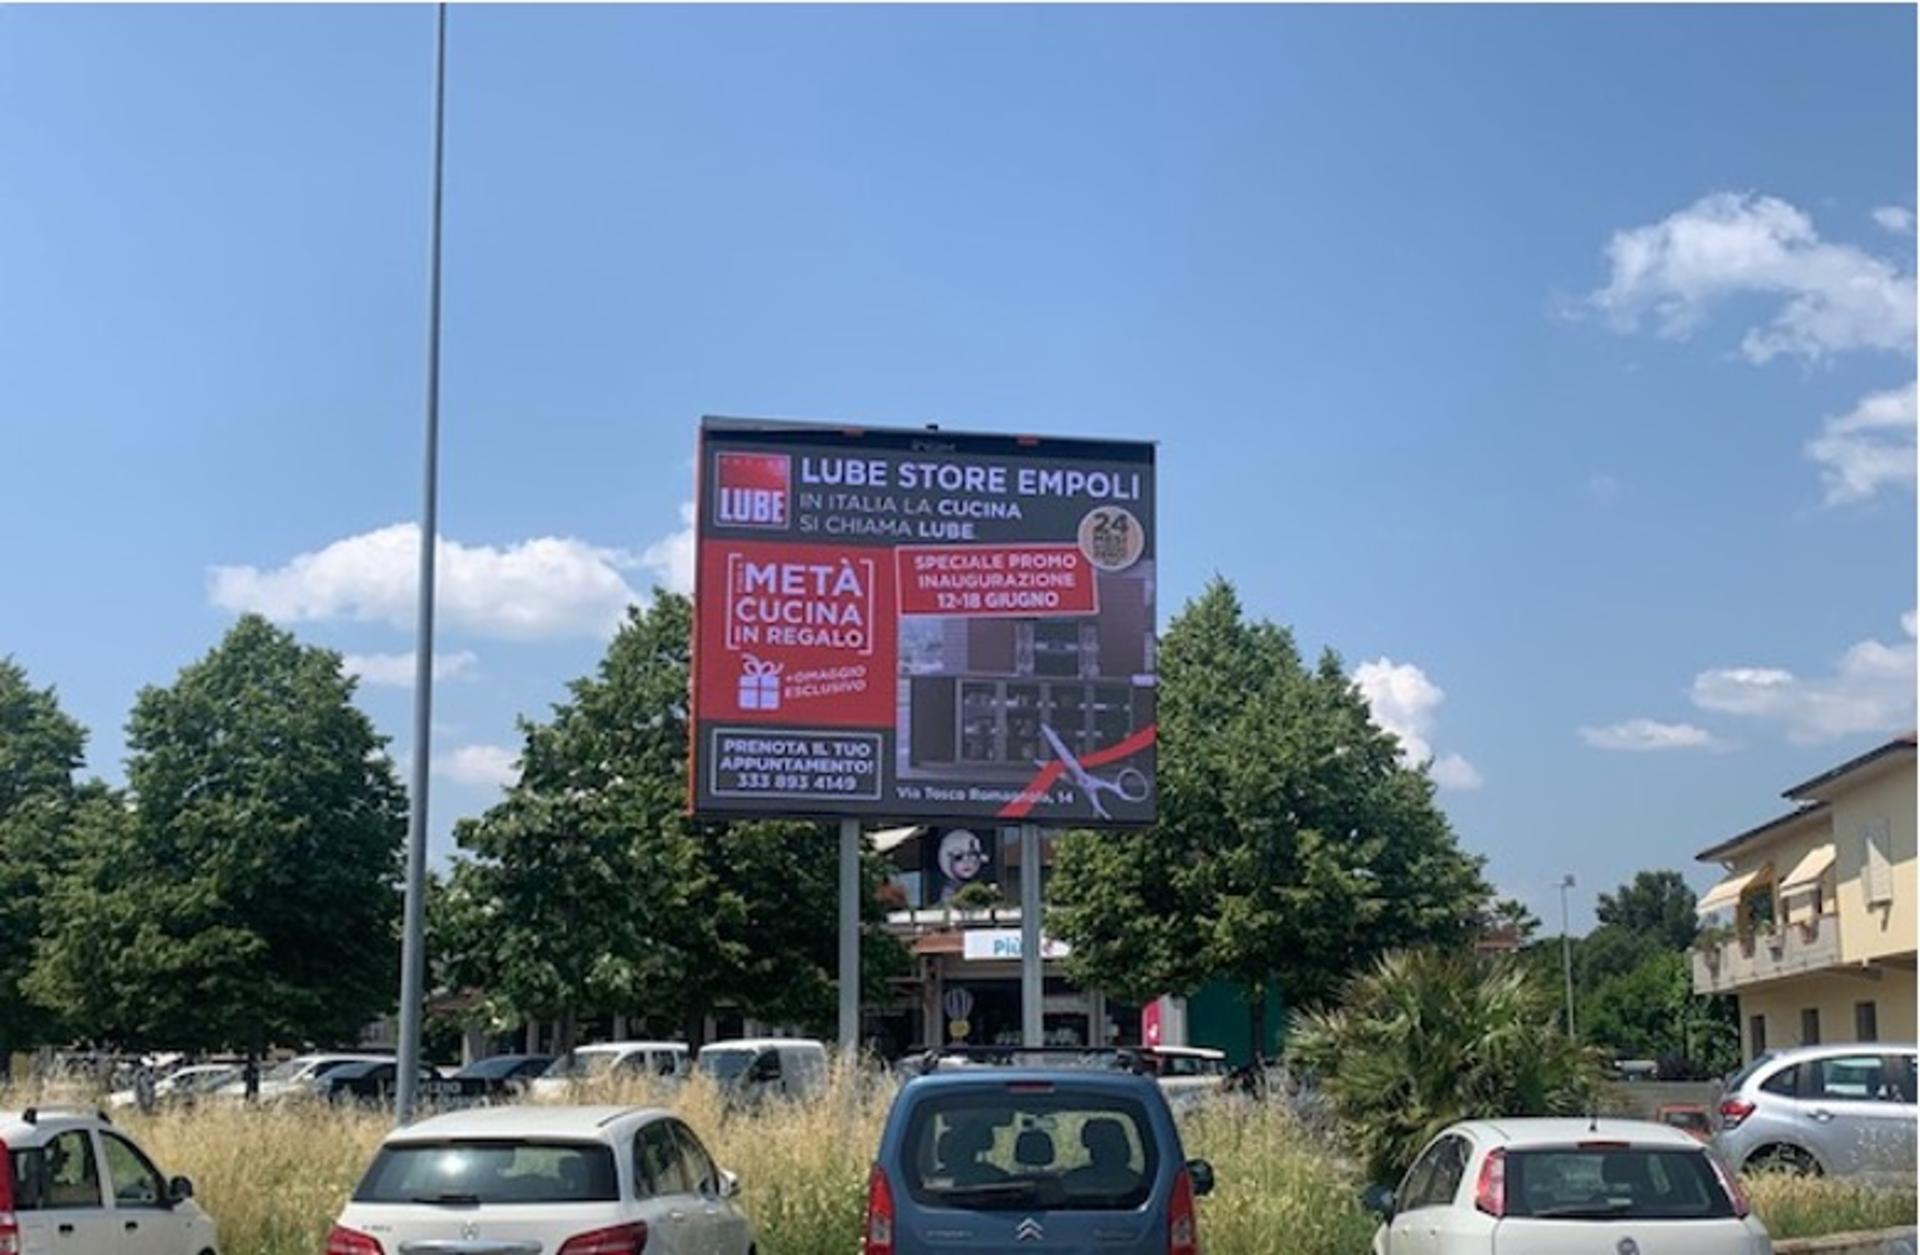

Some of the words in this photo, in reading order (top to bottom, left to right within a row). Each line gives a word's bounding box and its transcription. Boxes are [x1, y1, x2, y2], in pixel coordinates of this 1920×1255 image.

[802, 457, 887, 487] LUBE
[898, 462, 1007, 493] STORE
[1018, 469, 1140, 500] EMPOLI
[720, 488, 784, 523] LUBE
[801, 493, 822, 510] IN
[829, 494, 897, 514] ITALIA
[904, 498, 932, 515] LA
[938, 499, 1022, 520] CUCINA
[800, 514, 819, 533] SI
[826, 515, 911, 537] CHIAMA
[919, 521, 975, 540] LUBE
[1093, 512, 1129, 534] 24
[914, 554, 1004, 570] SPECIALE
[1008, 554, 1077, 570] PROMO
[745, 558, 863, 597] METÀ
[917, 573, 1076, 589] INAUGURAZIONE
[937, 592, 981, 609] 12-18
[985, 592, 1059, 608] GIUGNO
[736, 597, 863, 627] CUCINA
[735, 626, 759, 644] IN
[767, 627, 863, 648] REGALO
[785, 679, 867, 699] ESCLUSIVO
[724, 740, 808, 756] PRENOTA
[812, 742, 828, 756] IL
[834, 743, 871, 758] TUO
[720, 756, 873, 774] APPUNTAMENTO!
[738, 773, 769, 788] 333
[775, 774, 808, 789] 893
[813, 775, 857, 791] 4149
[896, 786, 920, 800] Via
[924, 787, 965, 801] Tosco
